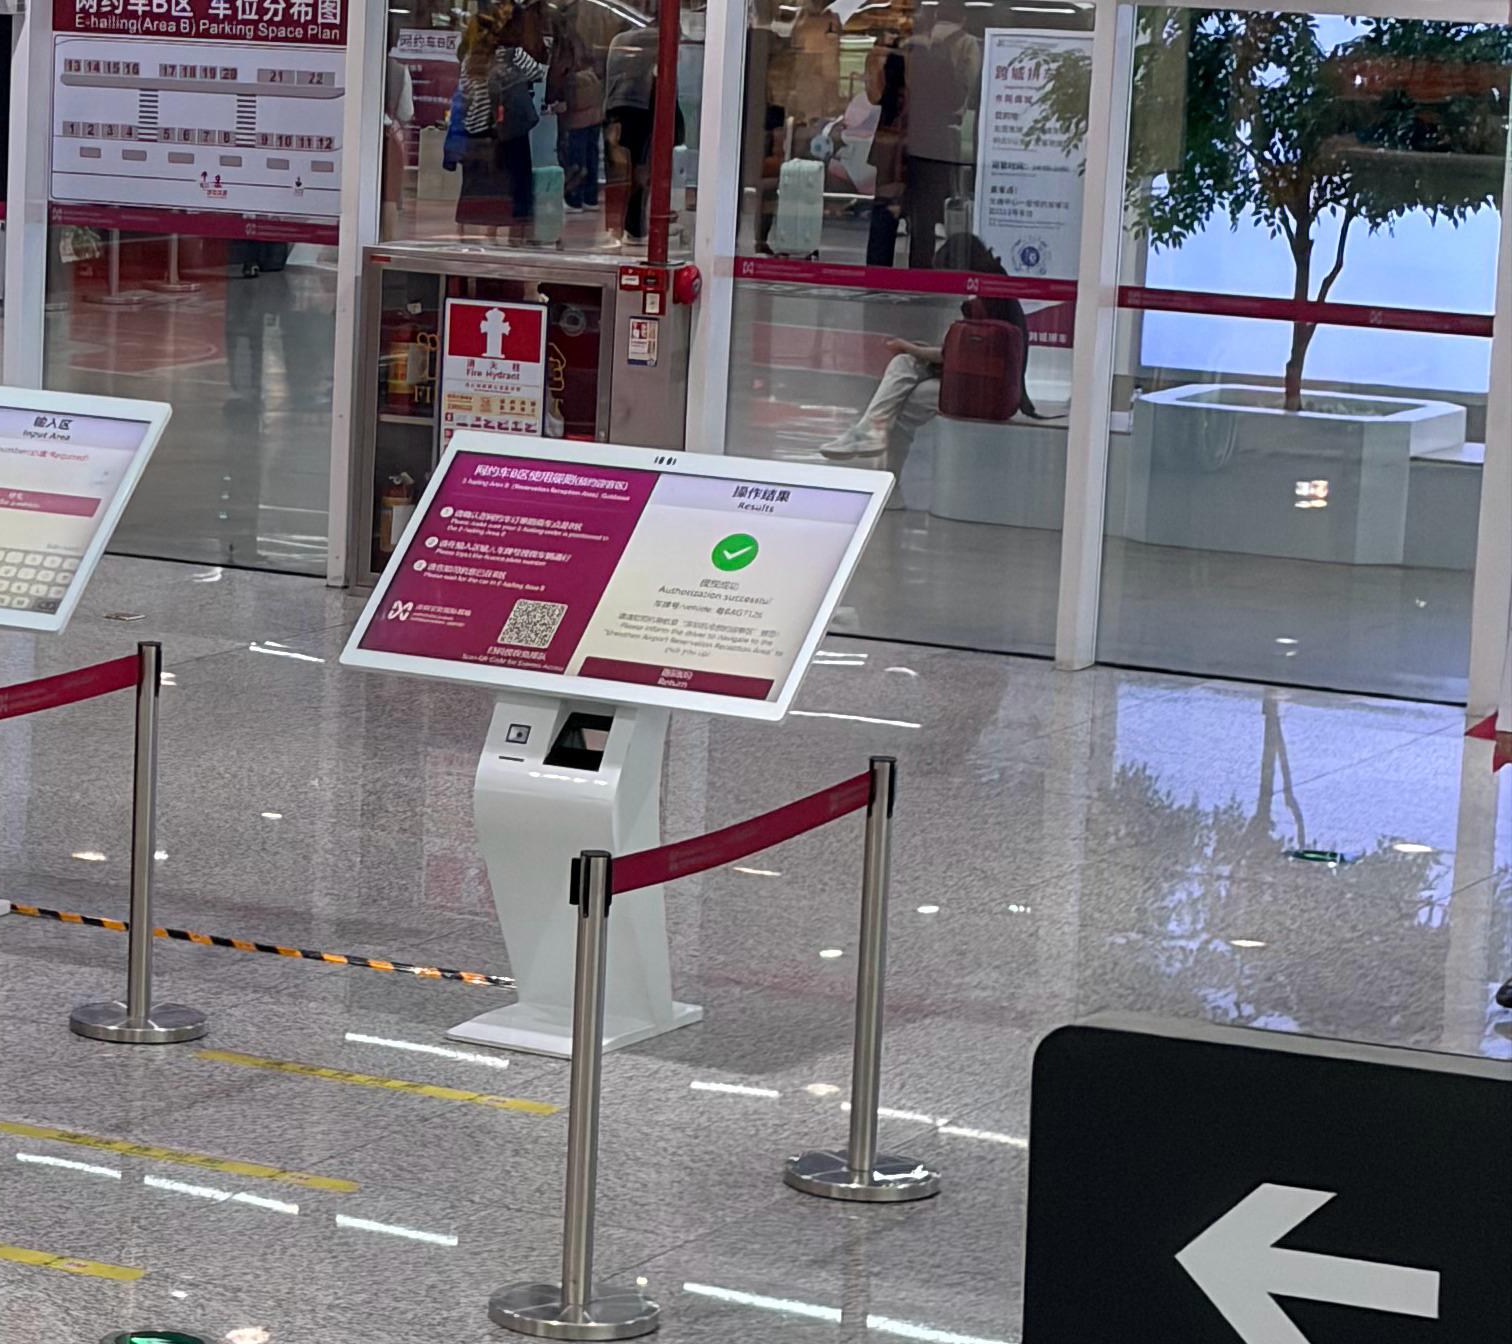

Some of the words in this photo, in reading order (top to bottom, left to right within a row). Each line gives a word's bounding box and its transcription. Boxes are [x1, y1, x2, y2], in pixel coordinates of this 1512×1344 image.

[199, 22, 255, 39] Parking
[258, 22, 303, 40] Space
[308, 24, 340, 40] Plan
[269, 70, 284, 83] 21
[732, 485, 791, 503] 操作结果
[738, 501, 775, 513] Results
